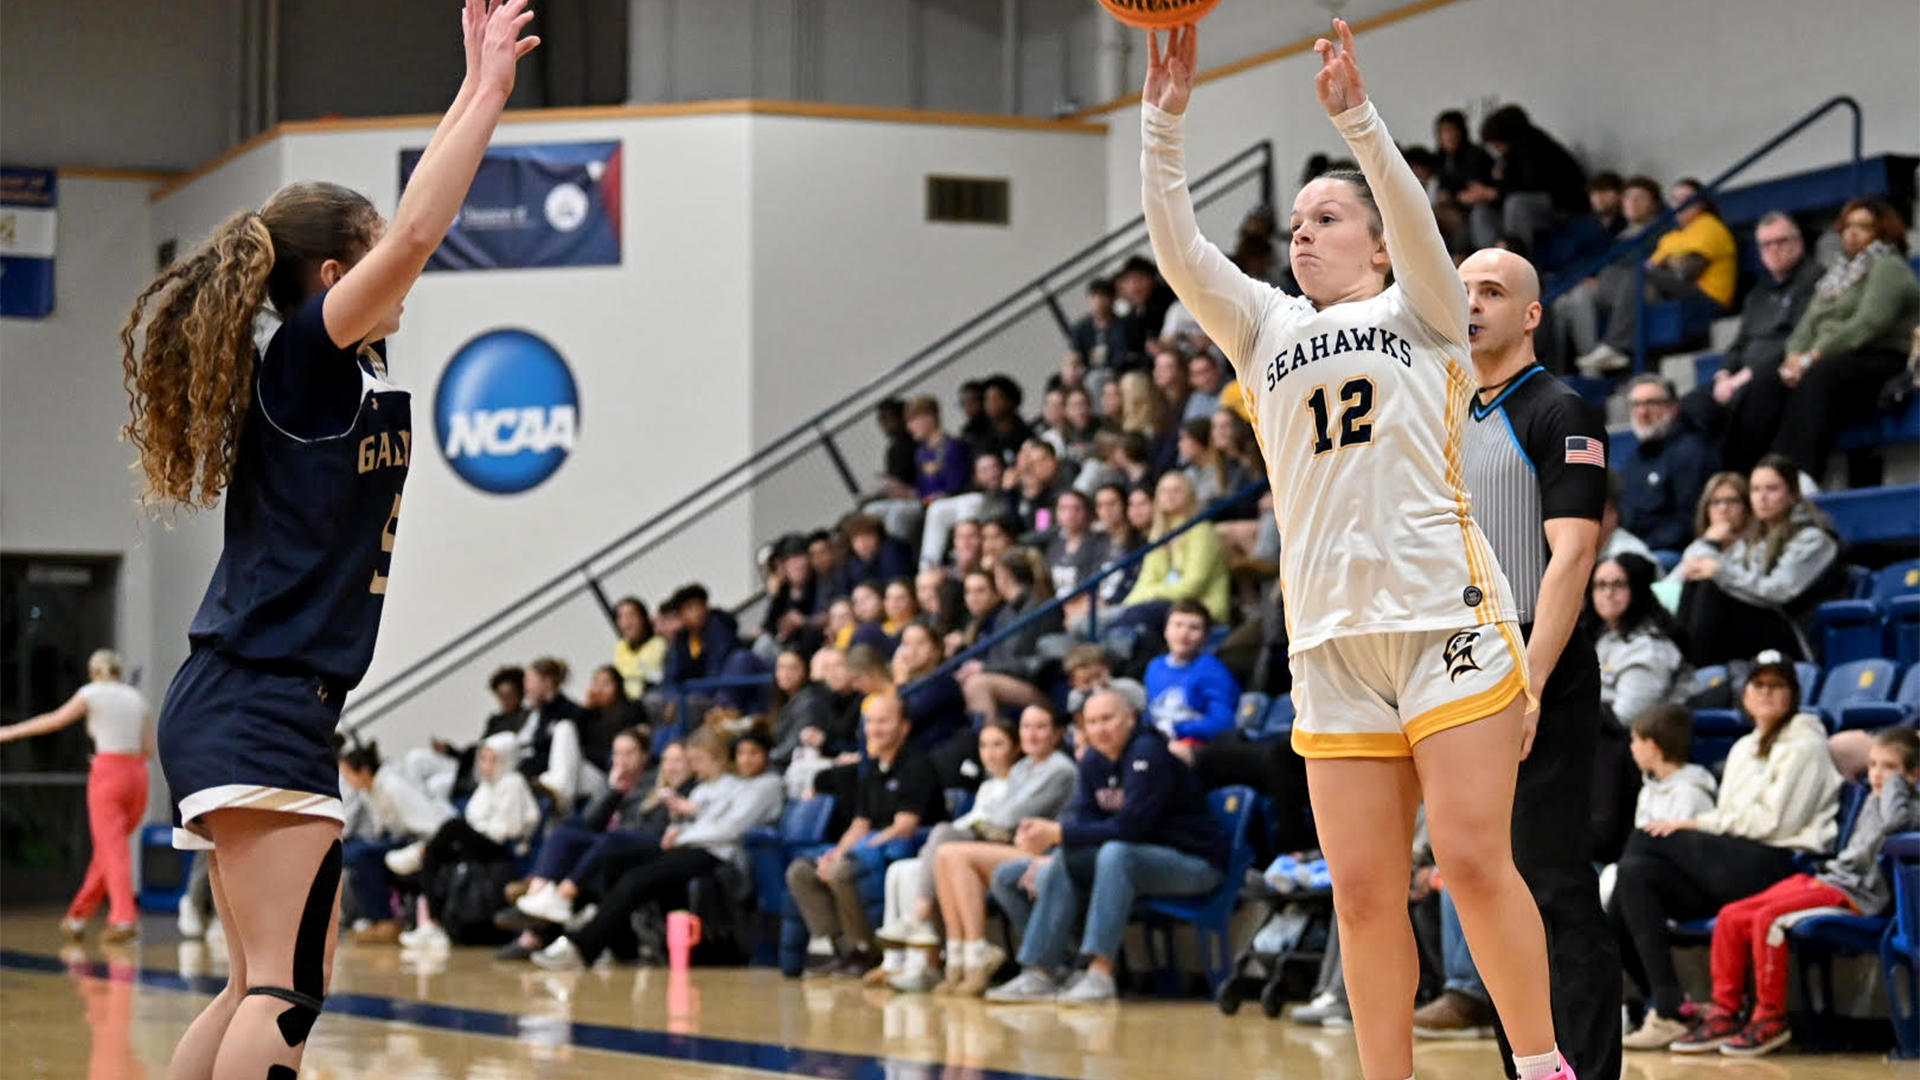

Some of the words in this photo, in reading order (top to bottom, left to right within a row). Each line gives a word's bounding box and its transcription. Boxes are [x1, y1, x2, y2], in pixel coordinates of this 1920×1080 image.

[1266, 327, 1412, 392] SEAHAWKS
[445, 405, 575, 458] NCAA
[1306, 375, 1377, 457] 12
